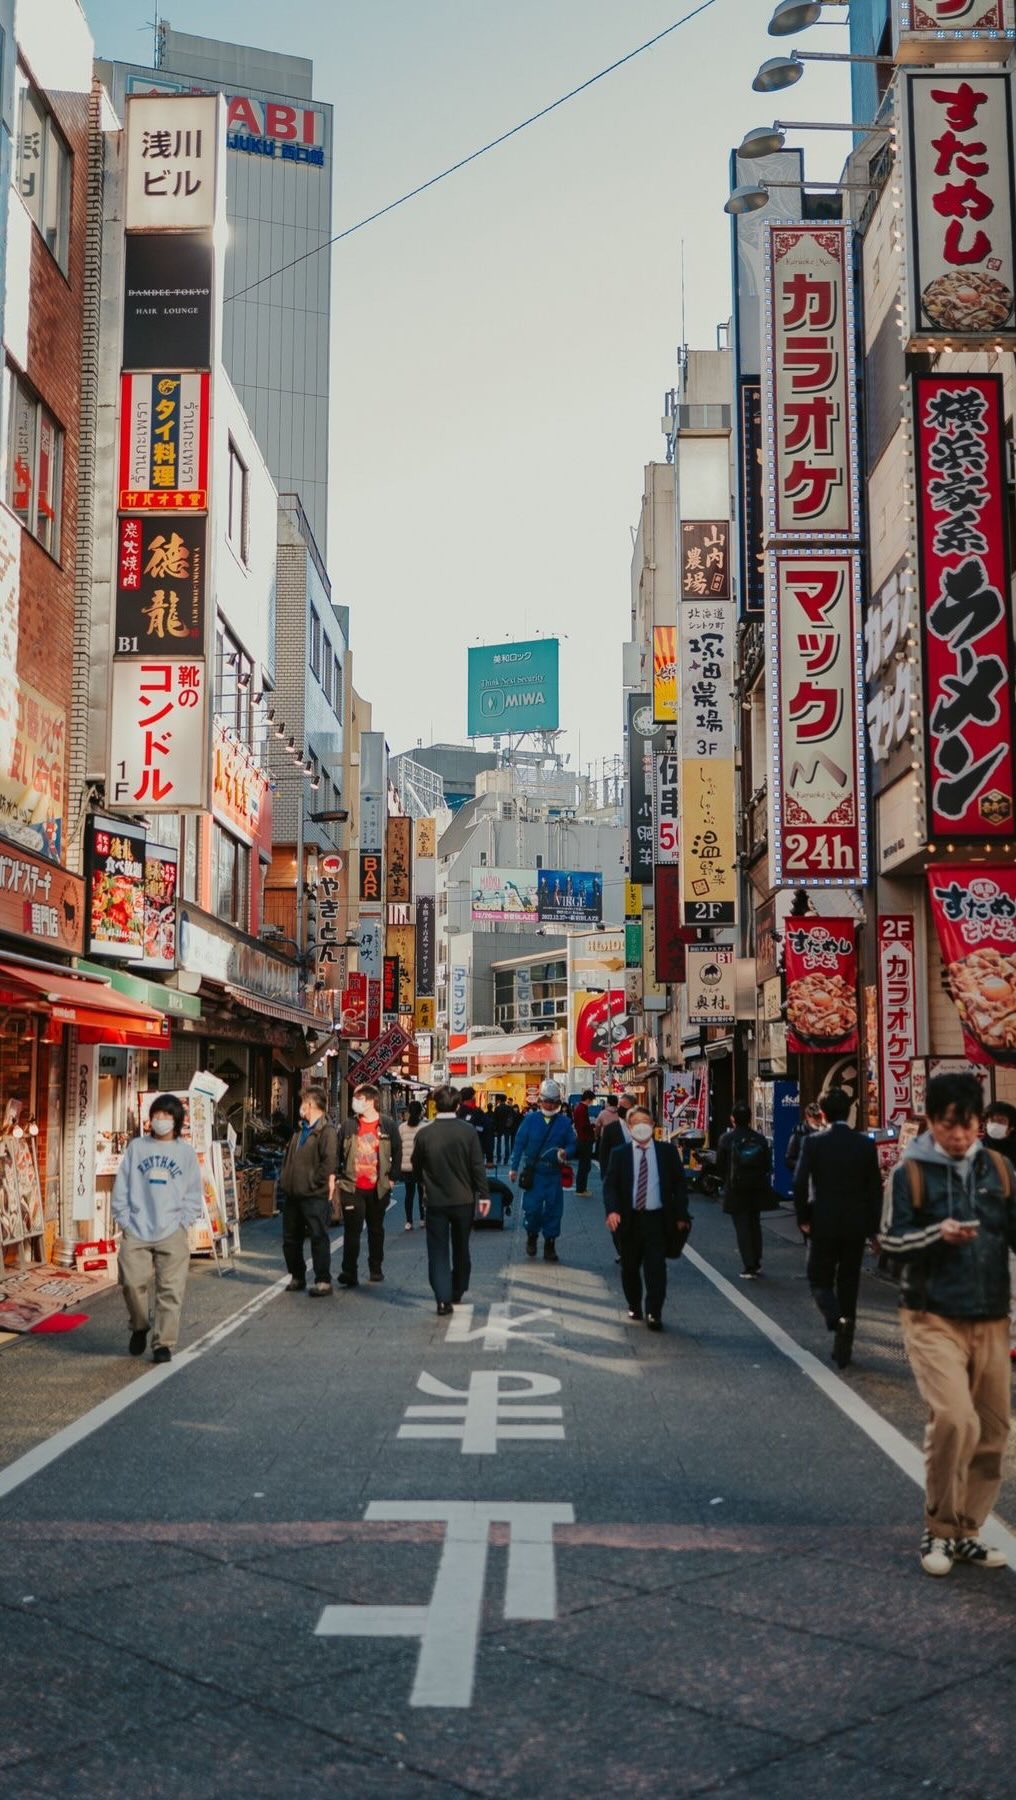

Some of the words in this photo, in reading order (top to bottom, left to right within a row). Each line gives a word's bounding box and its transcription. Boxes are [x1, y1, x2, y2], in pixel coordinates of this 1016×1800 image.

[141, 130, 201, 158] 浅川
[143, 169, 201, 197] ビル
[783, 273, 842, 520] カラオケ
[151, 398, 175, 487] タイ料理
[125, 492, 201, 506] ガパオ食堂
[123, 522, 138, 588] 炭火焼肉
[704, 524, 726, 569] 山内
[684, 546, 707, 594] 農場
[687, 607, 726, 620] 北海道
[926, 386, 1008, 820] 横浜家系ラーメン
[118, 636, 140, 652] B1
[493, 652, 532, 664] 美和ロック
[785, 569, 844, 744] マック
[177, 665, 200, 708] 靴の
[481, 679, 500, 688] Think
[502, 676, 516, 684] Next
[517, 672, 545, 684] Security
[505, 692, 546, 708] MIWA
[133, 665, 174, 802] コンドル
[696, 740, 718, 756] 3F
[114, 760, 129, 802] 1F
[659, 822, 679, 850] 5
[785, 833, 855, 870] 24h
[363, 857, 378, 898] BAR
[32, 903, 59, 938] 専門店
[320, 877, 340, 963] やきとん
[695, 902, 722, 919] 2F
[883, 921, 910, 937] 2F
[718, 952, 731, 963] B1
[695, 994, 727, 1010] 奥村
[886, 954, 911, 1127] カラオケマック
[137, 1155, 183, 1179] RHYTHMIC
[314, 1303, 576, 1708] 止まれ
